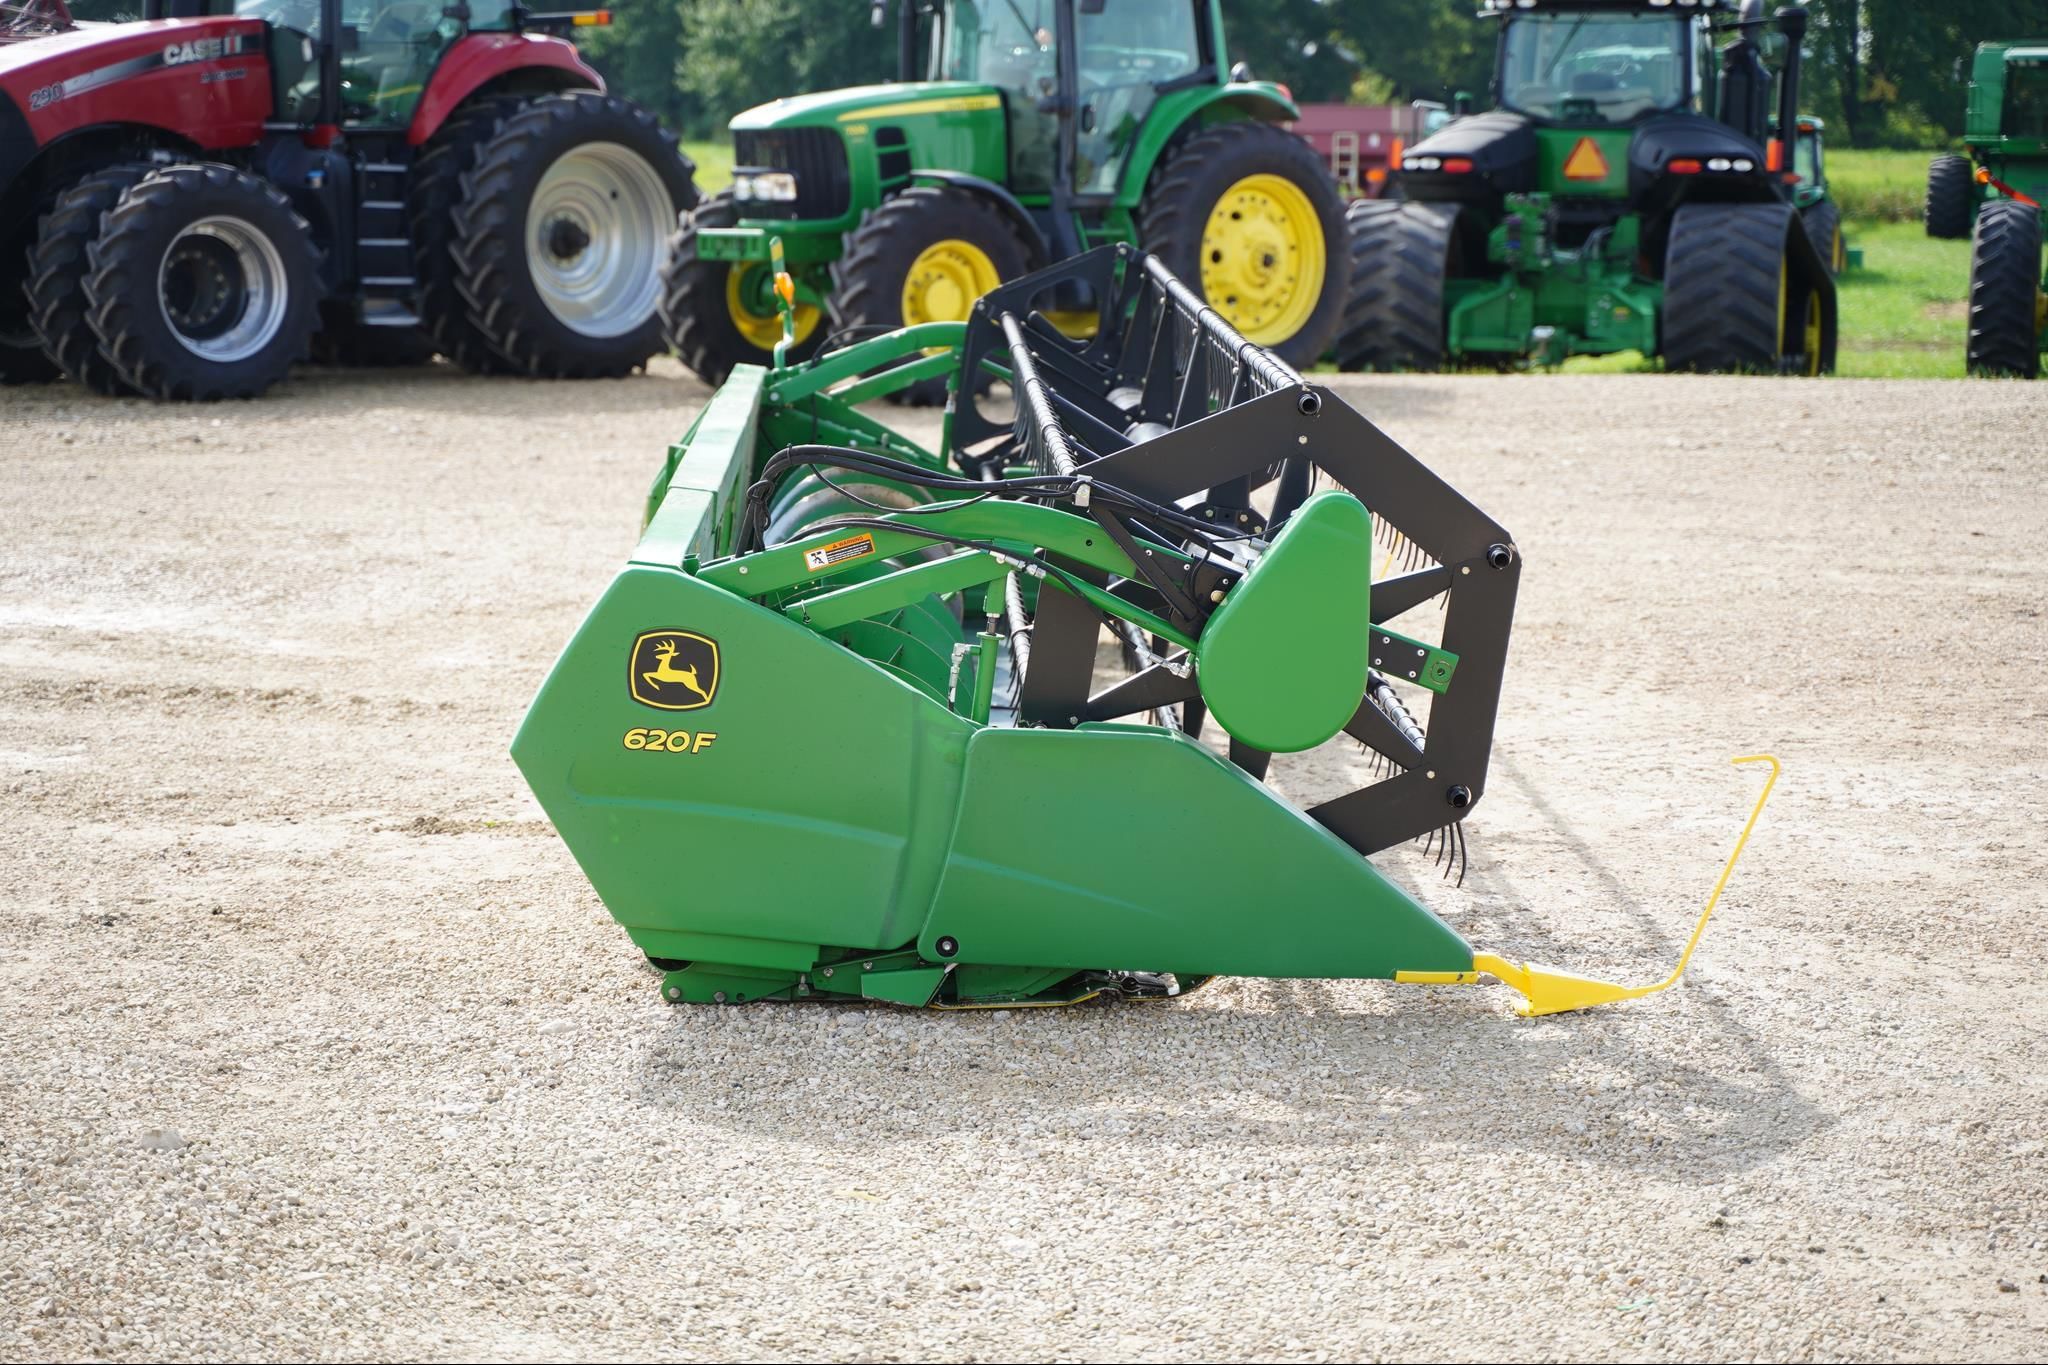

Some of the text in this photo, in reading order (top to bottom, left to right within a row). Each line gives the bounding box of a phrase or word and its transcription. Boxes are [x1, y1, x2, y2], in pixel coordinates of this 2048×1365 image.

[163, 37, 221, 66] CASE
[28, 81, 65, 112] 290
[838, 535, 864, 547] WARNING
[623, 726, 718, 754] 620F
